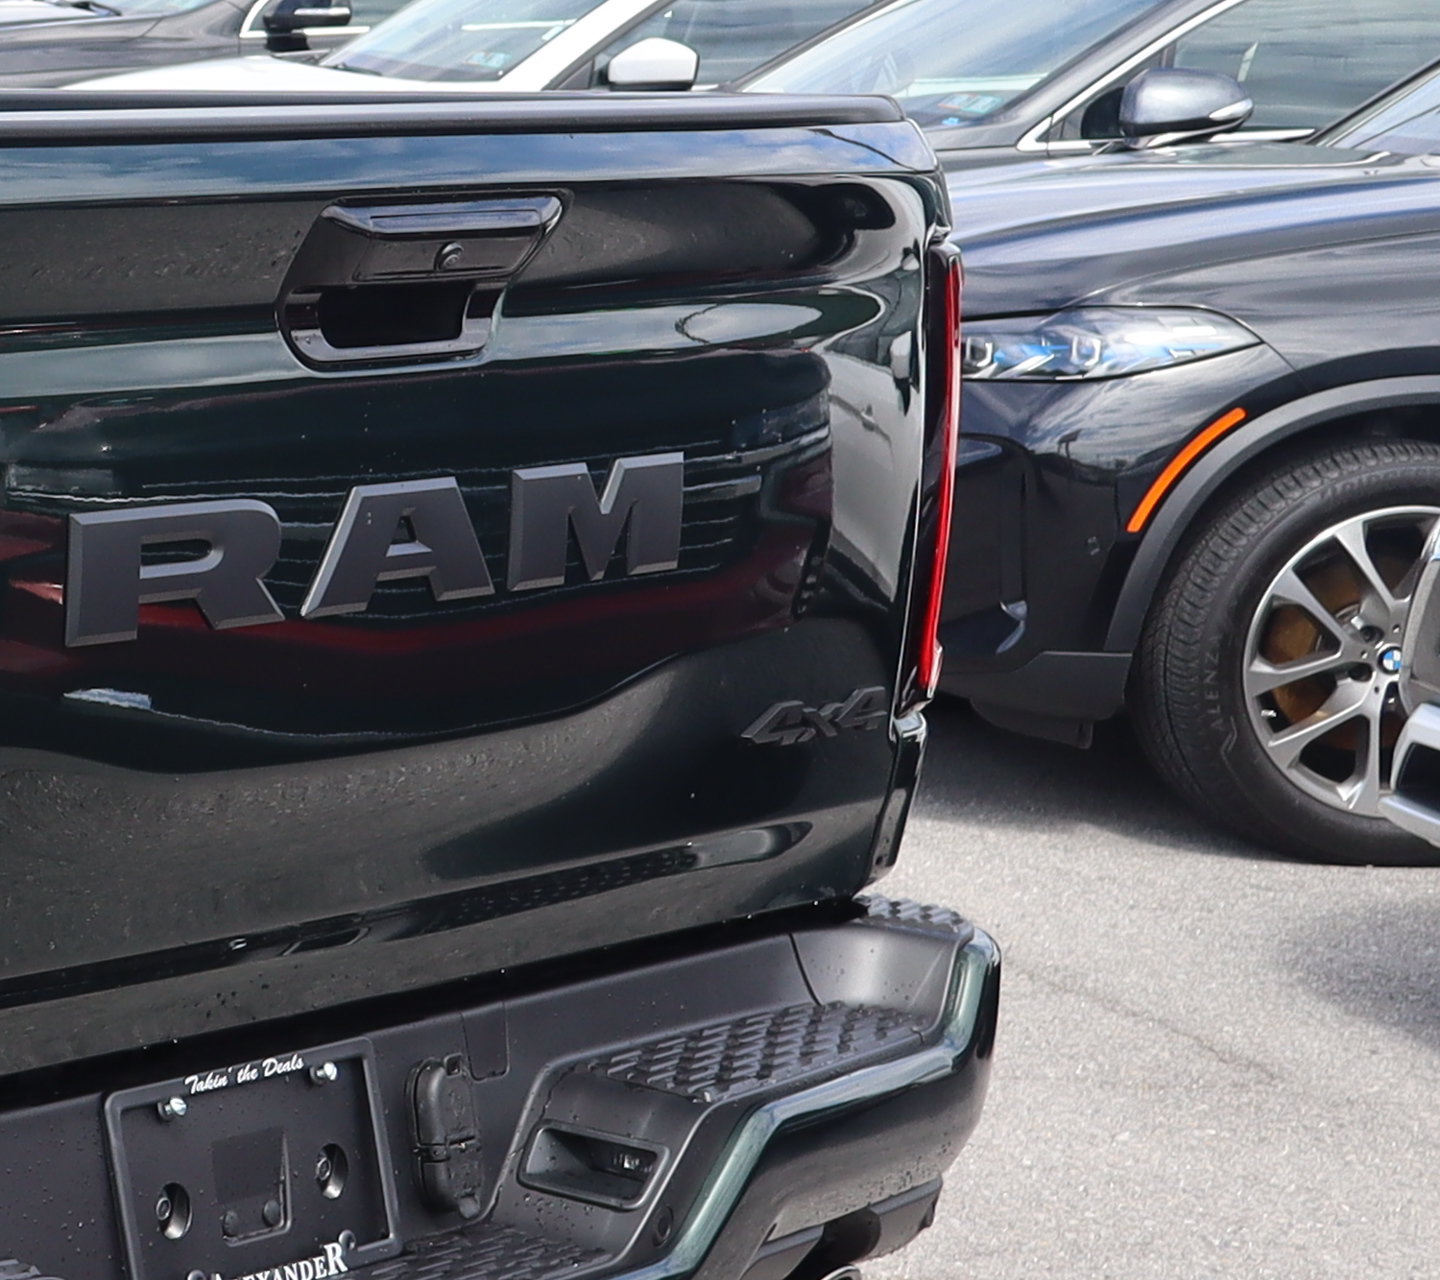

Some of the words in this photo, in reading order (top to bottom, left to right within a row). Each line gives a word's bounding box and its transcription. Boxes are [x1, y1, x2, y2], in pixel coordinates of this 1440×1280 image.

[64, 450, 685, 648] RAM
[236, 1063, 259, 1084] the
[262, 1053, 305, 1078] Deals
